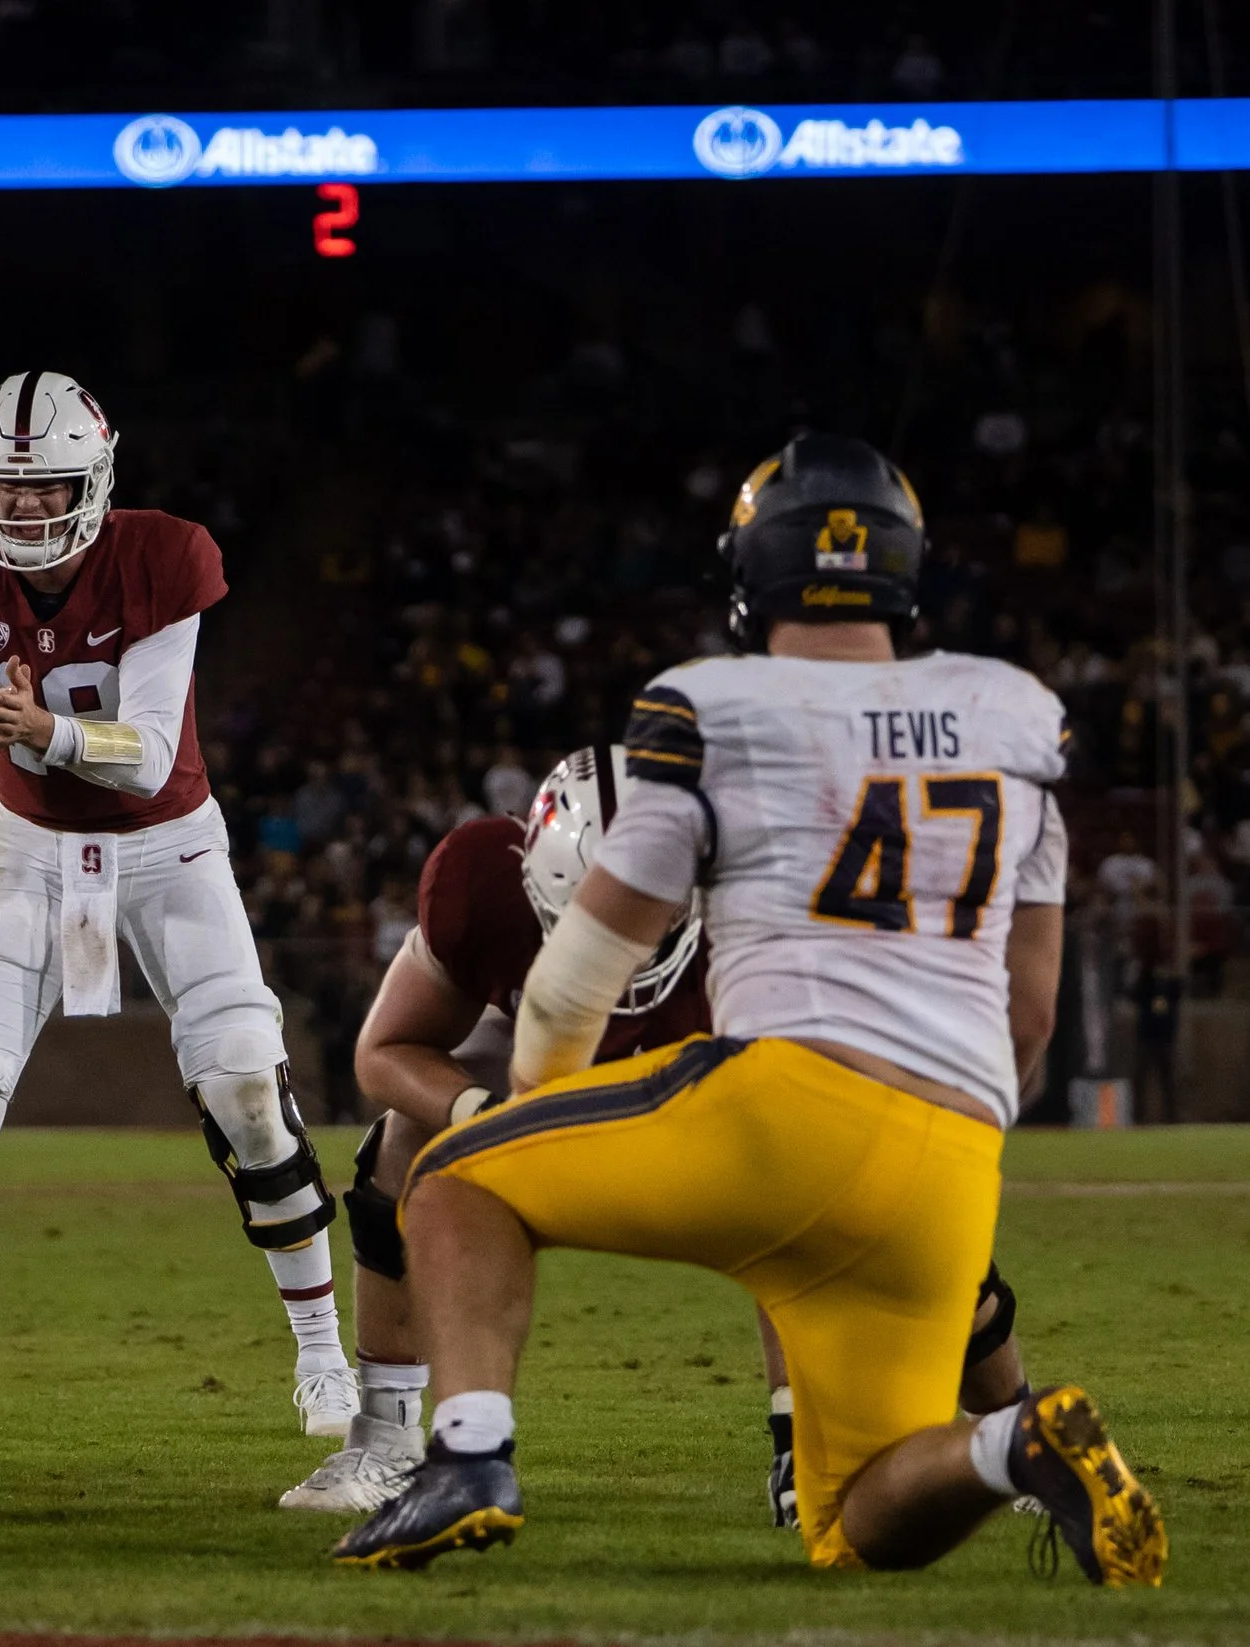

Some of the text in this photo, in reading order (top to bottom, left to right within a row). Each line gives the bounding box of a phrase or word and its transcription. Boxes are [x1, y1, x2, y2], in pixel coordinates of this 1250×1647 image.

[195, 126, 379, 176] Allstate
[775, 119, 964, 168] Allstate
[314, 183, 359, 257] 2
[862, 709, 961, 760] TEVIS
[809, 770, 1005, 941] 47
